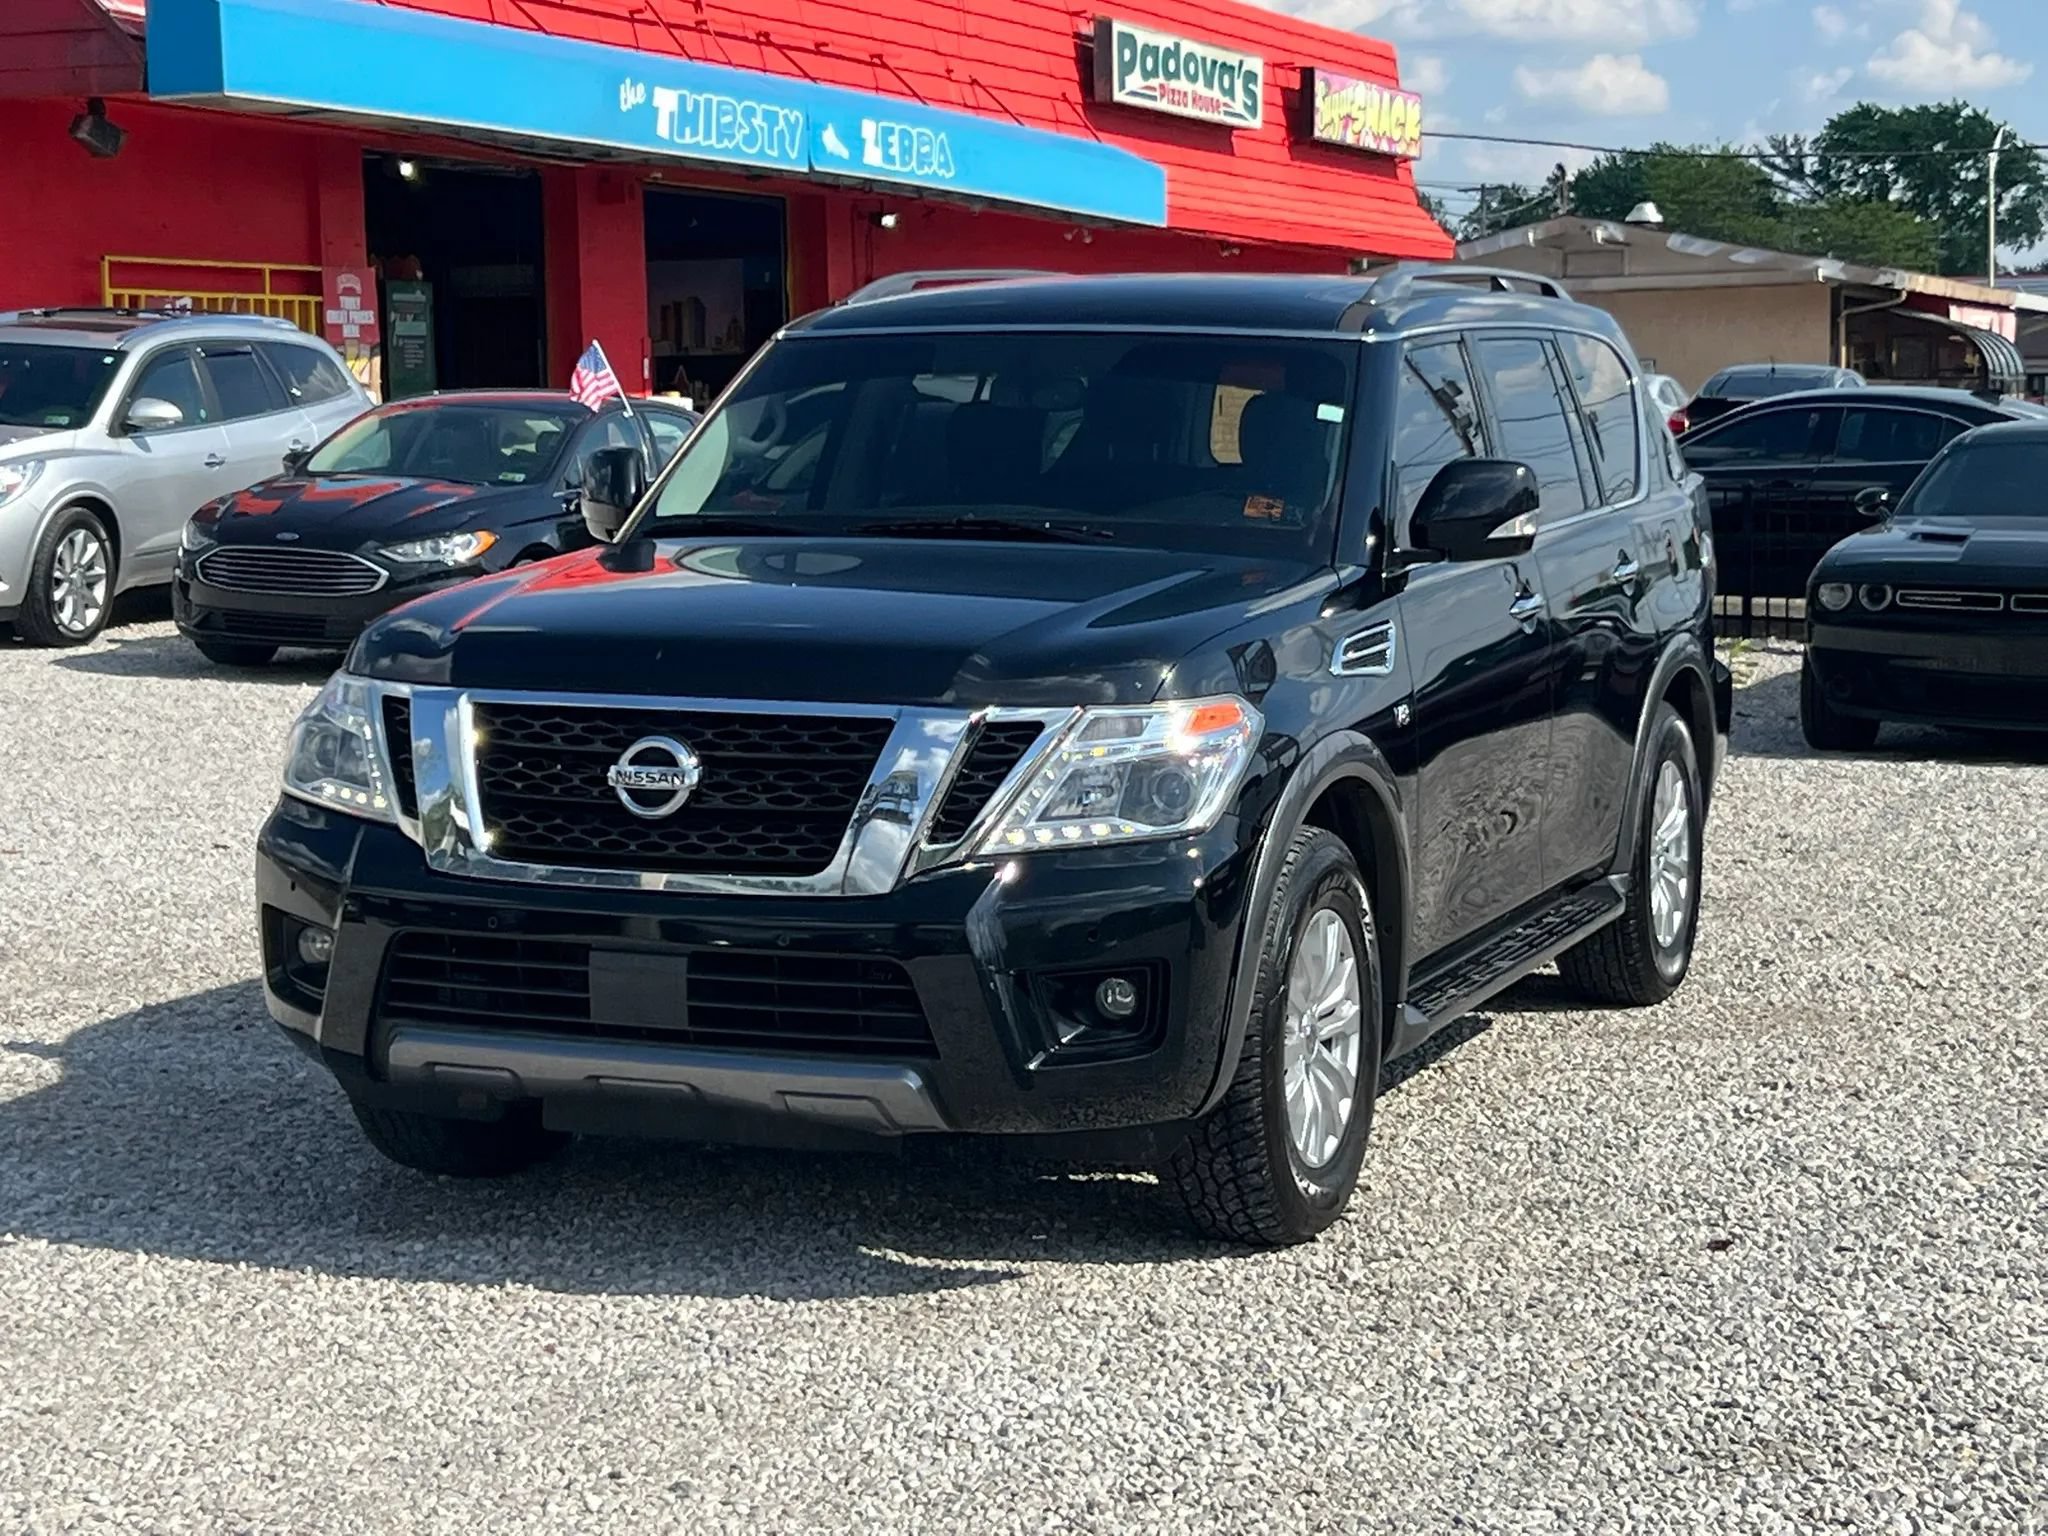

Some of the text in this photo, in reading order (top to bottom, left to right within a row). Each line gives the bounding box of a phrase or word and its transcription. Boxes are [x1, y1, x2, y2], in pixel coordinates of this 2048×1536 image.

[1117, 31, 1259, 121] Padova's
[1158, 83, 1222, 115] Pizza House
[619, 77, 955, 178] the THIRSTY ZEBRA
[615, 769, 686, 786] NISSAN
